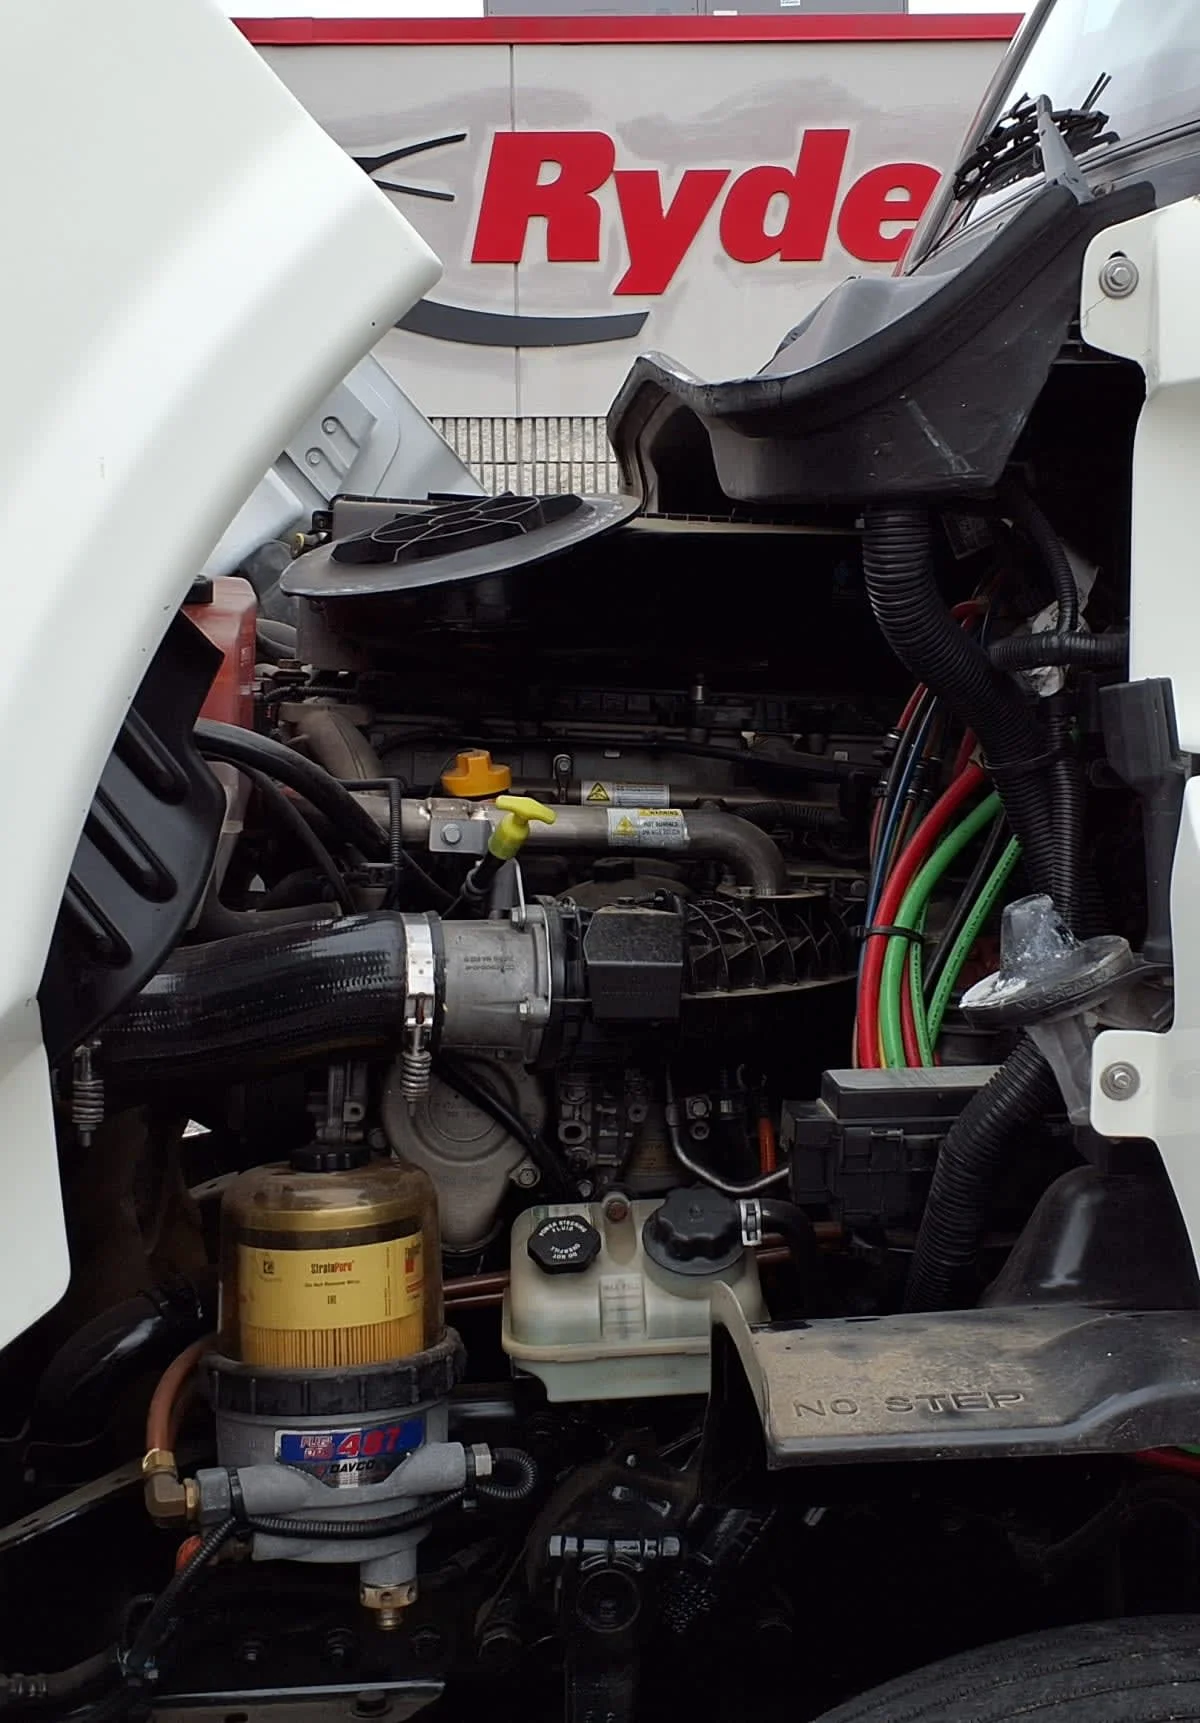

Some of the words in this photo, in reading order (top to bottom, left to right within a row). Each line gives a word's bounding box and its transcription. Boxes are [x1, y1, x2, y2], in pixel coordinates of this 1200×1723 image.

[792, 1398, 859, 1417] NO
[884, 1390, 1025, 1413] STEP
[330, 1459, 376, 1473] DAVCO
